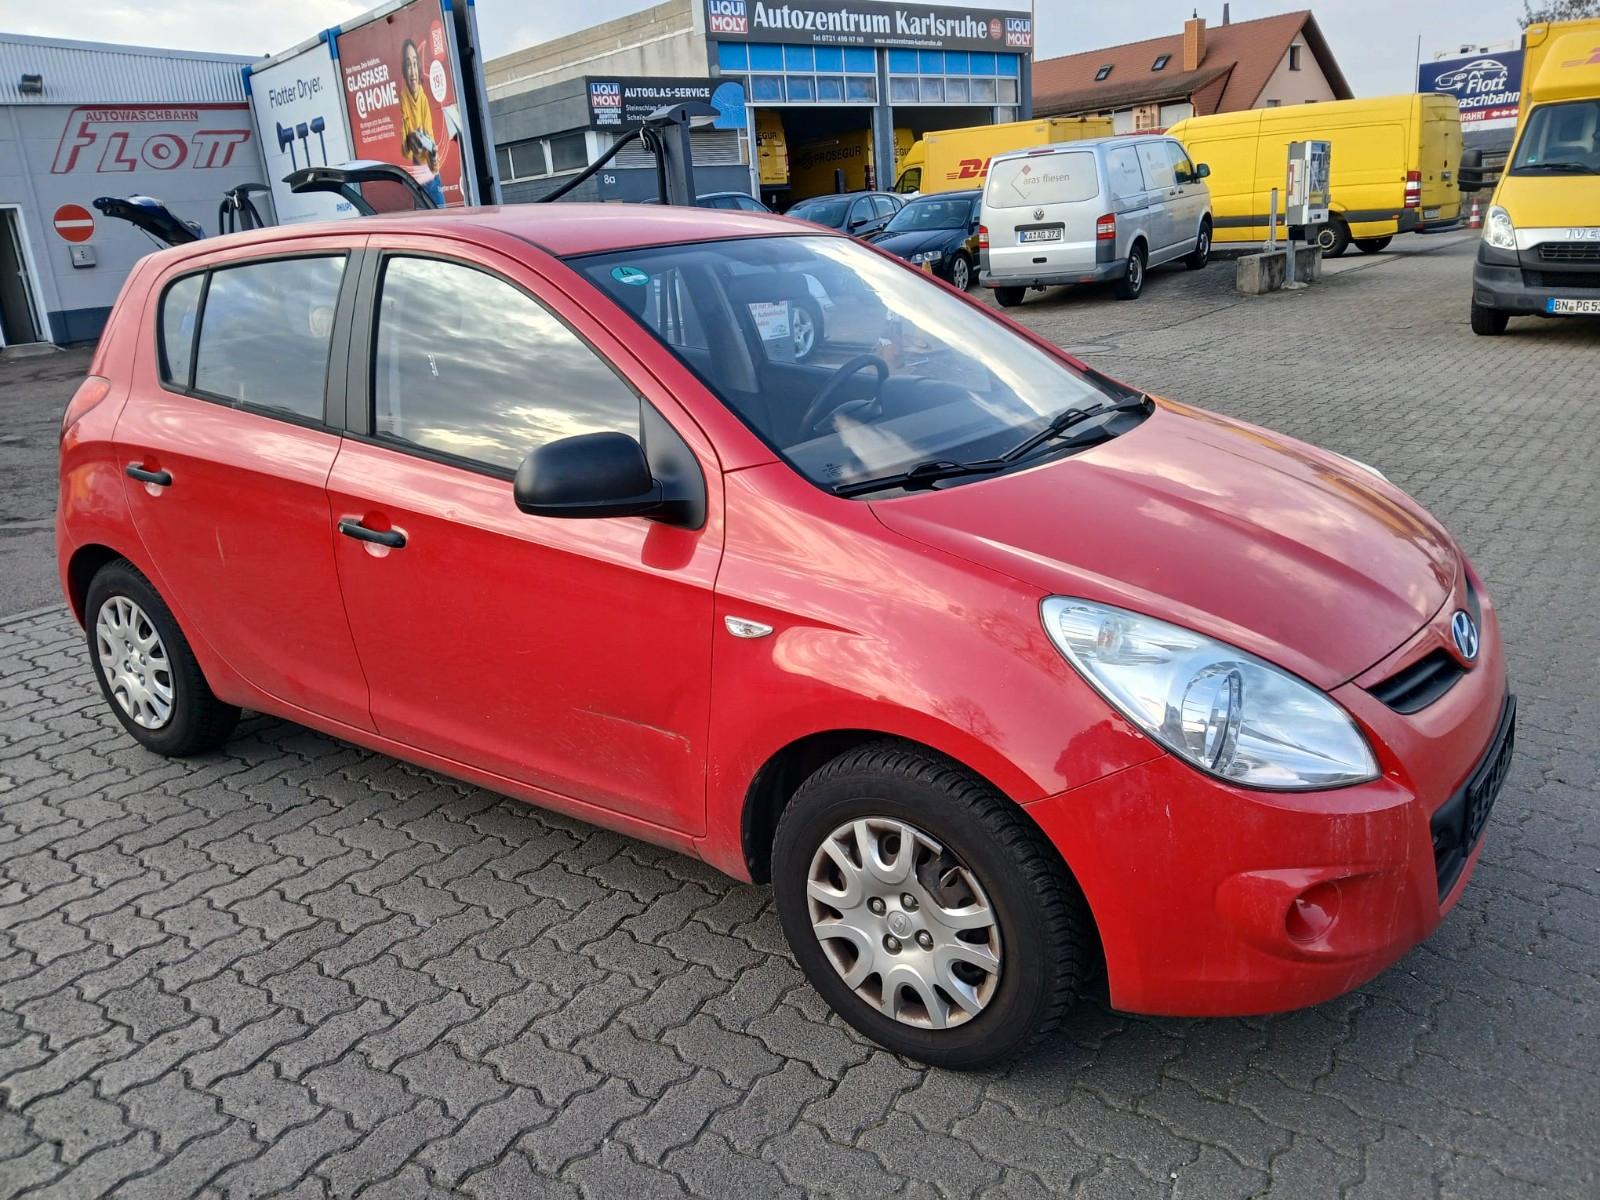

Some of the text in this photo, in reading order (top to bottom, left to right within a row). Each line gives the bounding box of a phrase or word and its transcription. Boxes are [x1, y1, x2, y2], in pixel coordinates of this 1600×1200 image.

[711, 0, 745, 16] LIQUI
[711, 17, 746, 31] MOLY
[753, 2, 988, 39] Autozentrum Karlsruhe
[1006, 19, 1030, 32] LIQUI
[1007, 33, 1031, 45] MOLY
[347, 64, 389, 92] GLASFASER
[592, 84, 619, 95] LIQUI
[1466, 76, 1507, 94] Flott
[269, 76, 323, 109] Flotter Dryer.
[624, 87, 711, 98] AUTOGLAS-SERVICE
[356, 82, 399, 119] @HOME
[593, 95, 621, 106] MOLY
[86, 110, 198, 121] AUTOWASCHBAHN
[51, 109, 251, 174] FLOTT
[814, 145, 862, 164] PROSEGUR
[604, 175, 615, 184] 8a
[1023, 173, 1070, 185] aras fliesen
[336, 203, 352, 212] PHILIPS
[1023, 233, 1033, 241] KA
[1047, 231, 1060, 239] 373
[1566, 229, 1600, 239] IVE
[1554, 300, 1568, 311] BN
[1576, 301, 1590, 312] PG
